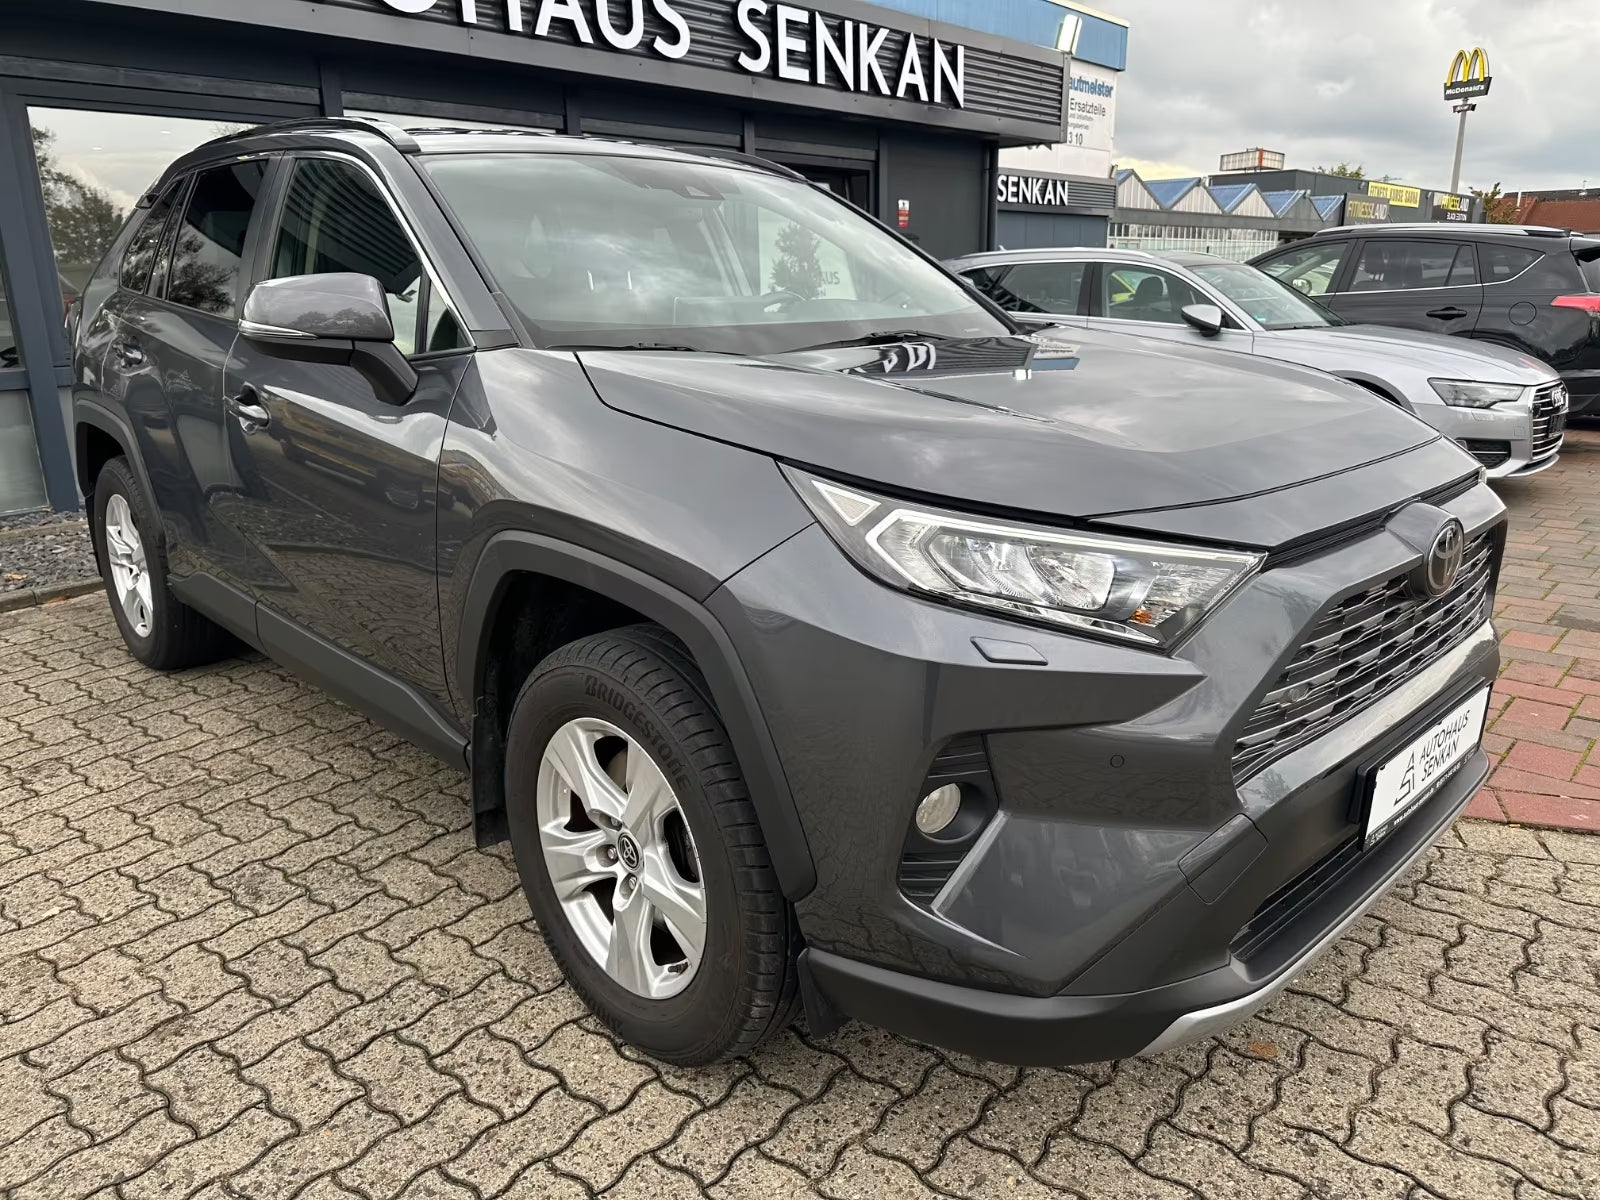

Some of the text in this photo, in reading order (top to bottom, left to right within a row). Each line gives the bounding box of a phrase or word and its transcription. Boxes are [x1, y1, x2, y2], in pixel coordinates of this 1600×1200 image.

[737, 0, 965, 109] SENKAN
[1070, 98, 1106, 117] Ersatzteile
[1445, 84, 1485, 96] McDonald's
[997, 175, 1049, 206] SENKAN
[1347, 200, 1388, 220] FITNESSLAND
[585, 674, 691, 791] BRIDGESTONE
[1419, 709, 1471, 765] AUTOHAUS
[1421, 735, 1460, 782] SENKAN
